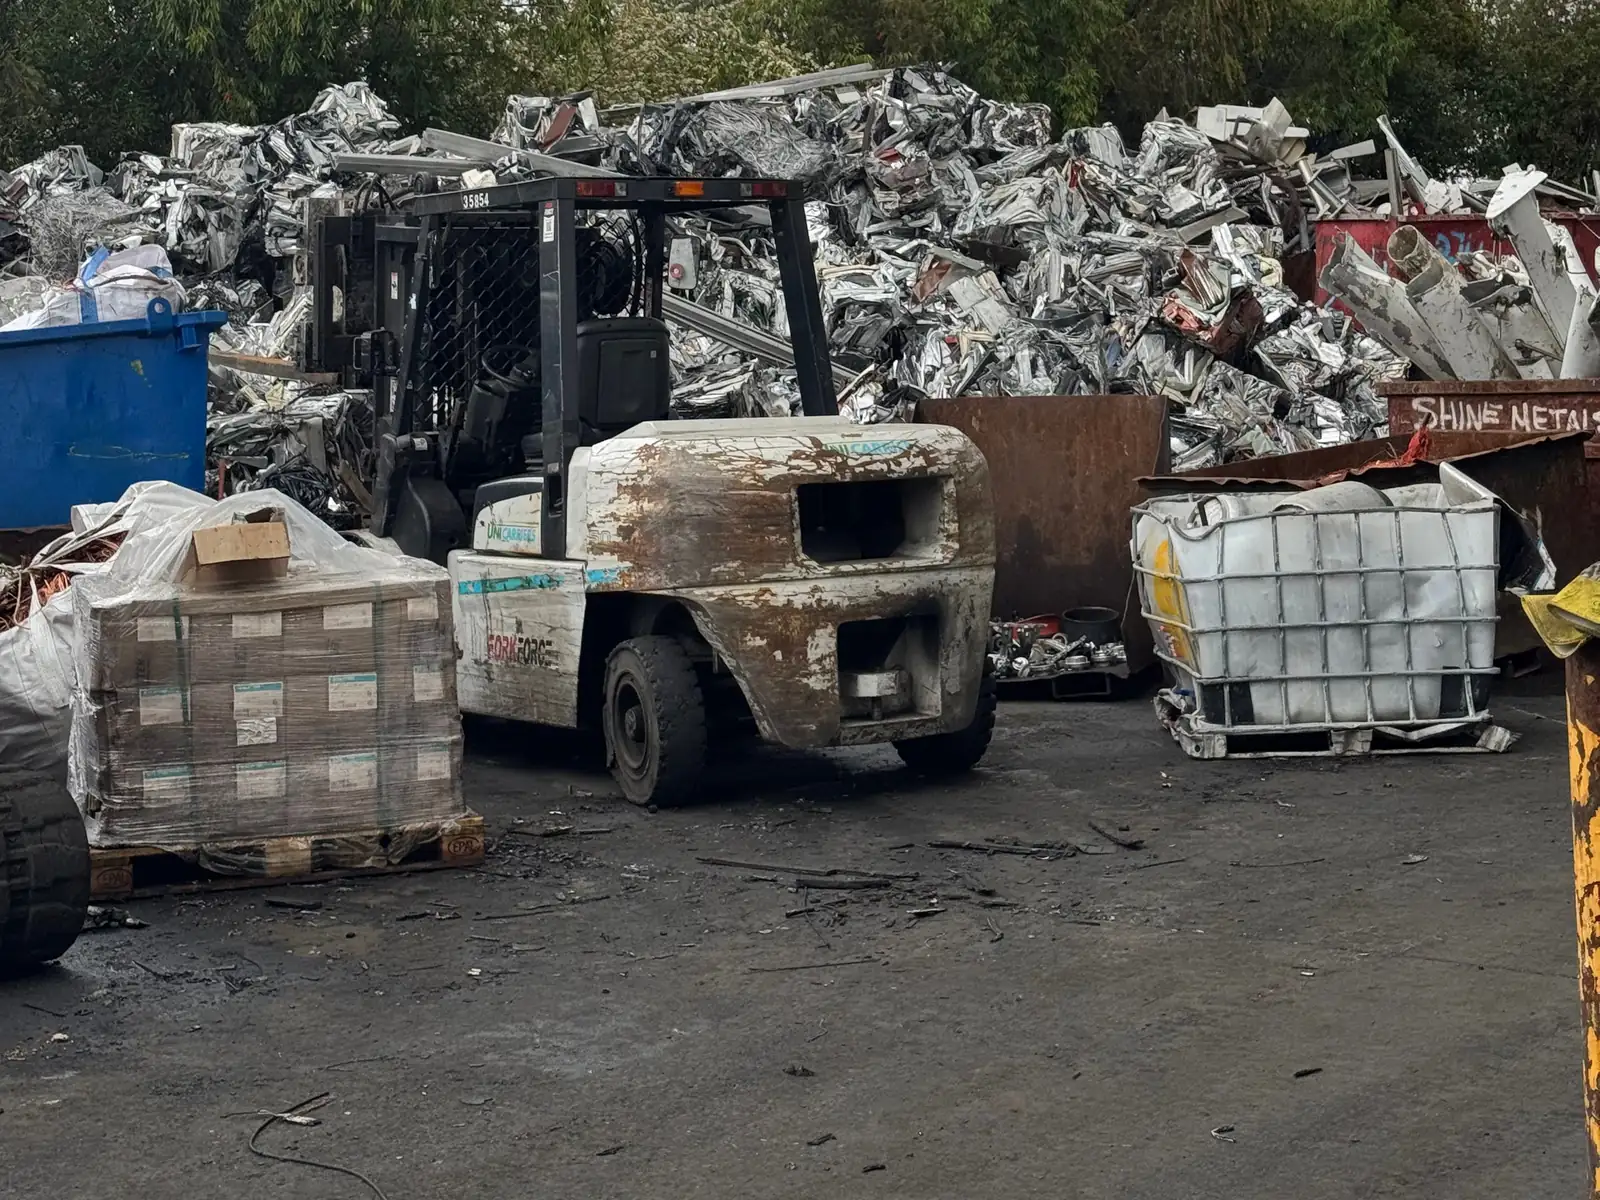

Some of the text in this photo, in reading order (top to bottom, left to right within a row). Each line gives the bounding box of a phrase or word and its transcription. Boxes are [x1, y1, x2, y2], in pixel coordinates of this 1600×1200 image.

[463, 192, 489, 209] 35854
[1412, 396, 1503, 431] SHINE
[488, 634, 559, 666] FORKFORCE
